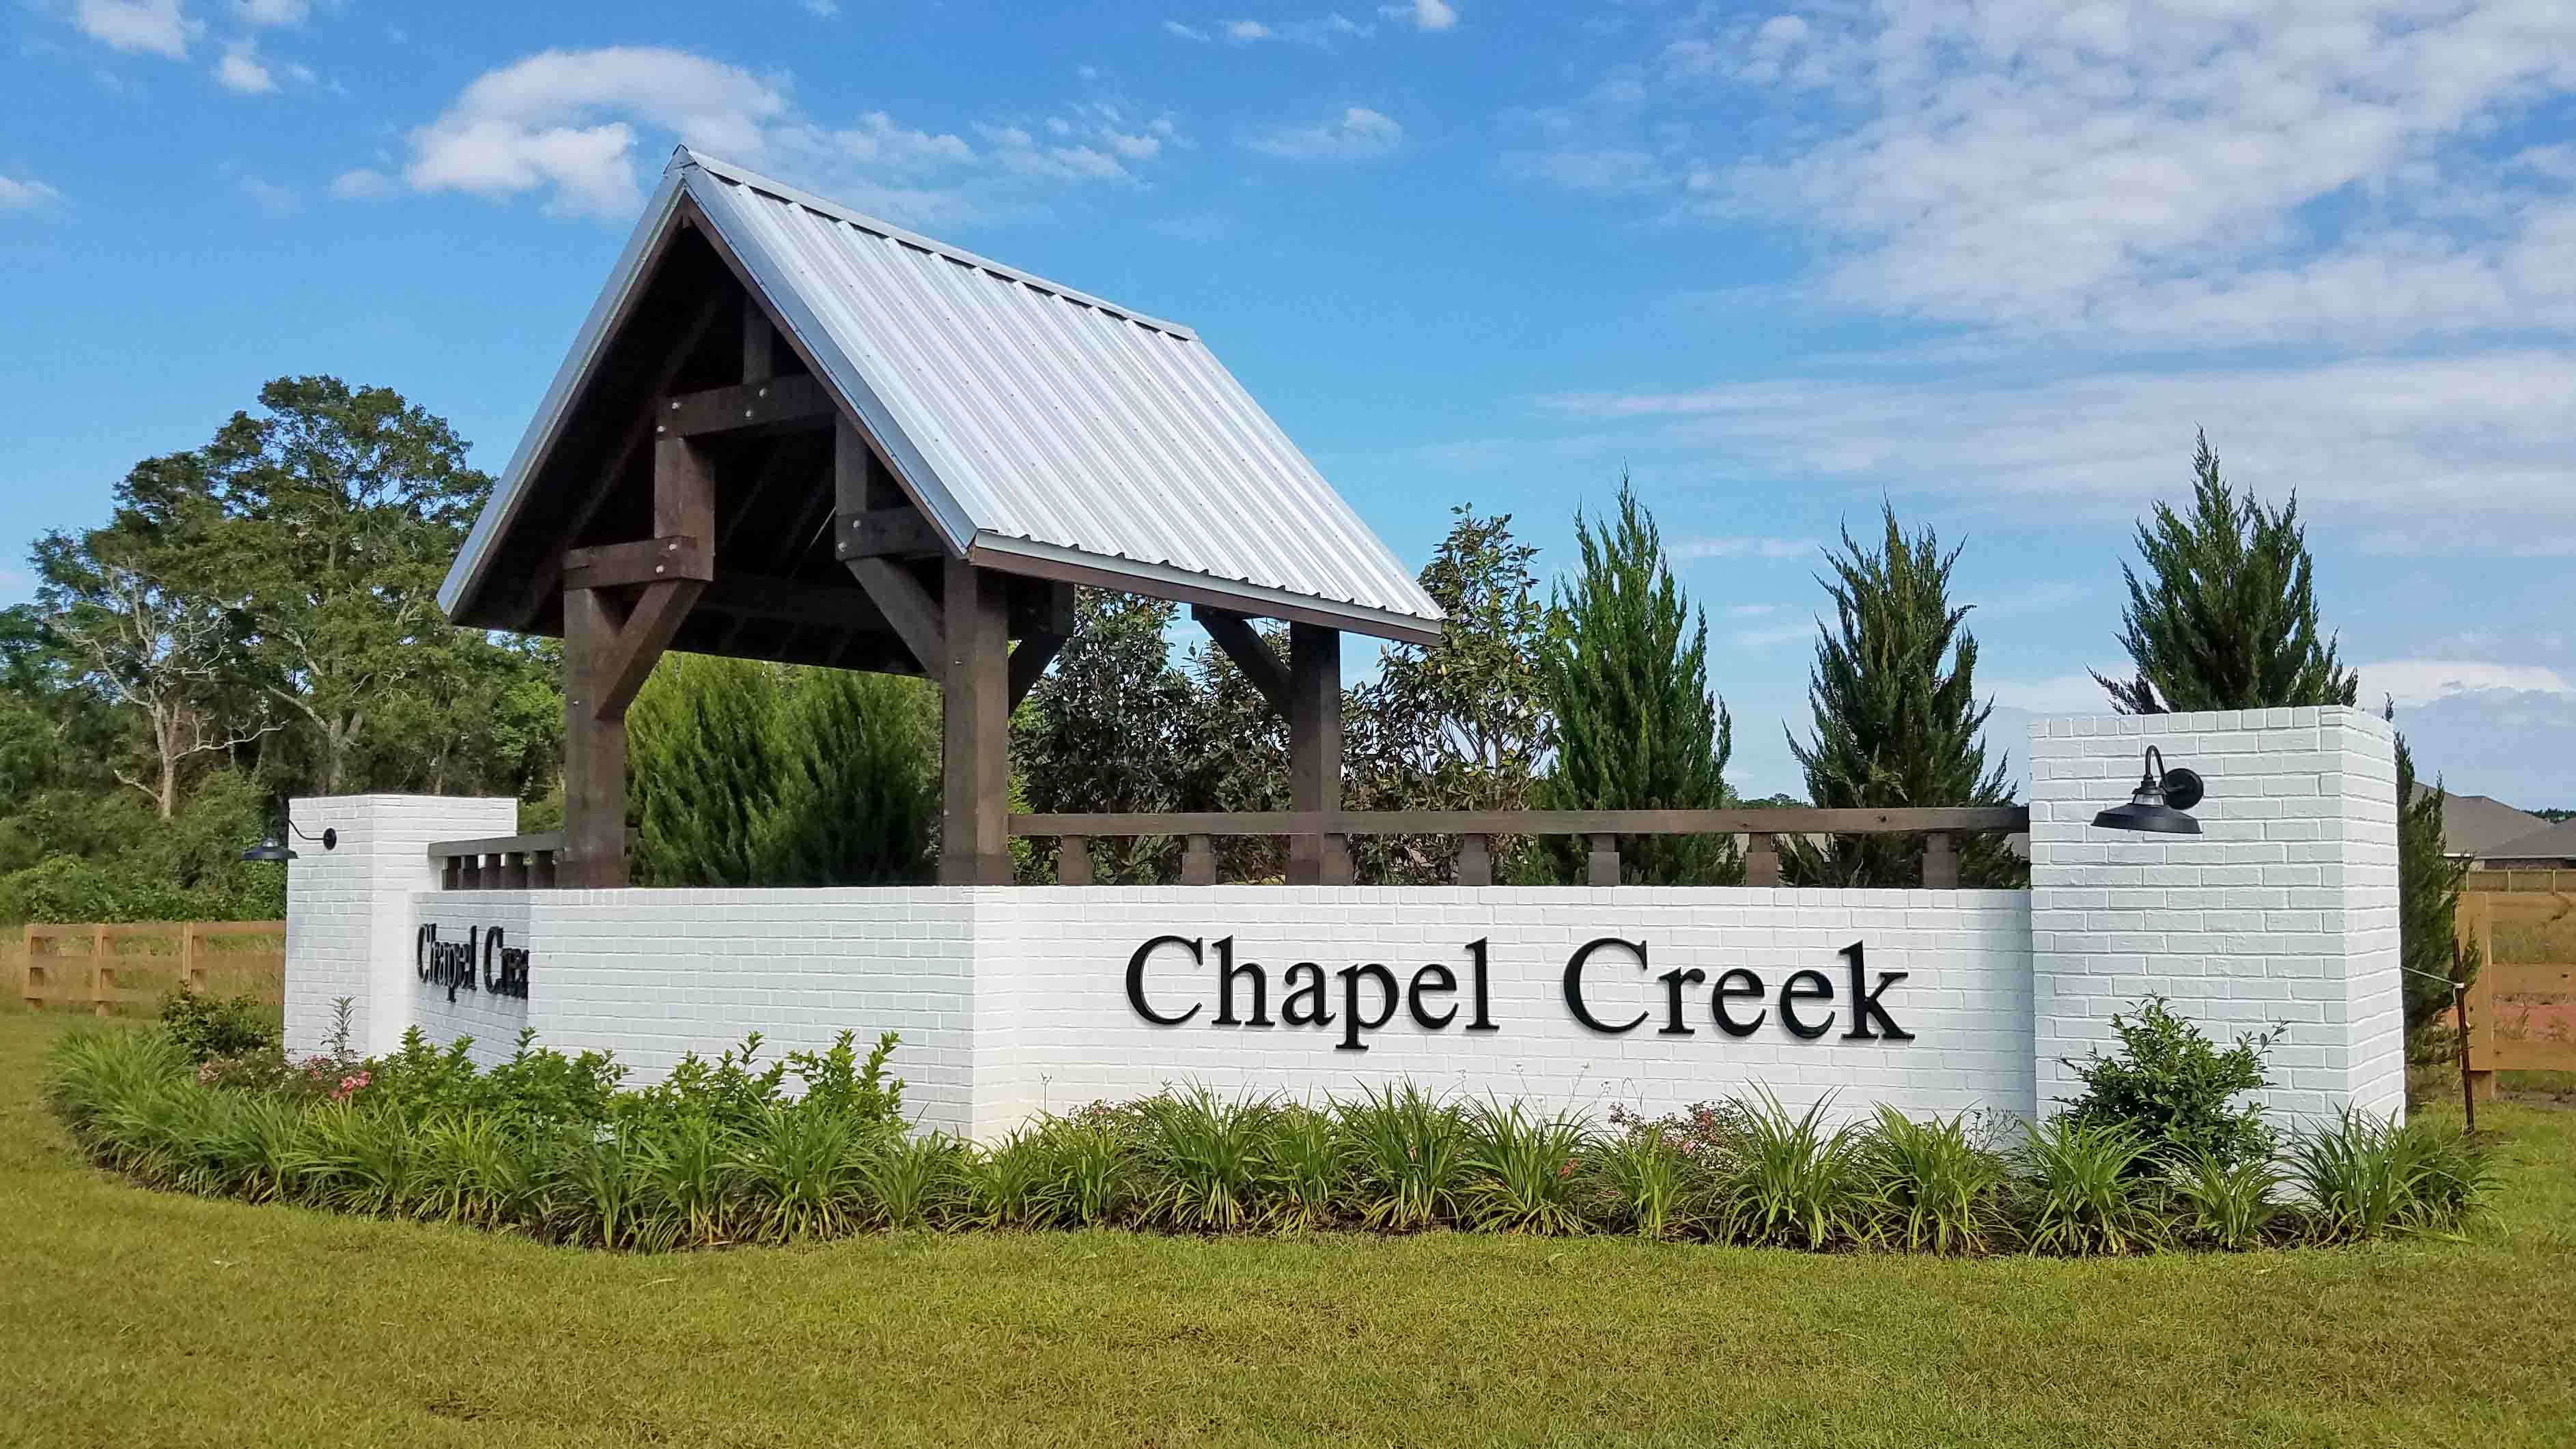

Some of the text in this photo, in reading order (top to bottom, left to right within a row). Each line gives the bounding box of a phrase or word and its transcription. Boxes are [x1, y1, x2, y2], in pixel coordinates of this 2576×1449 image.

[417, 923, 477, 1002] Chapel
[1126, 935, 1916, 1052] Chapel Creek
